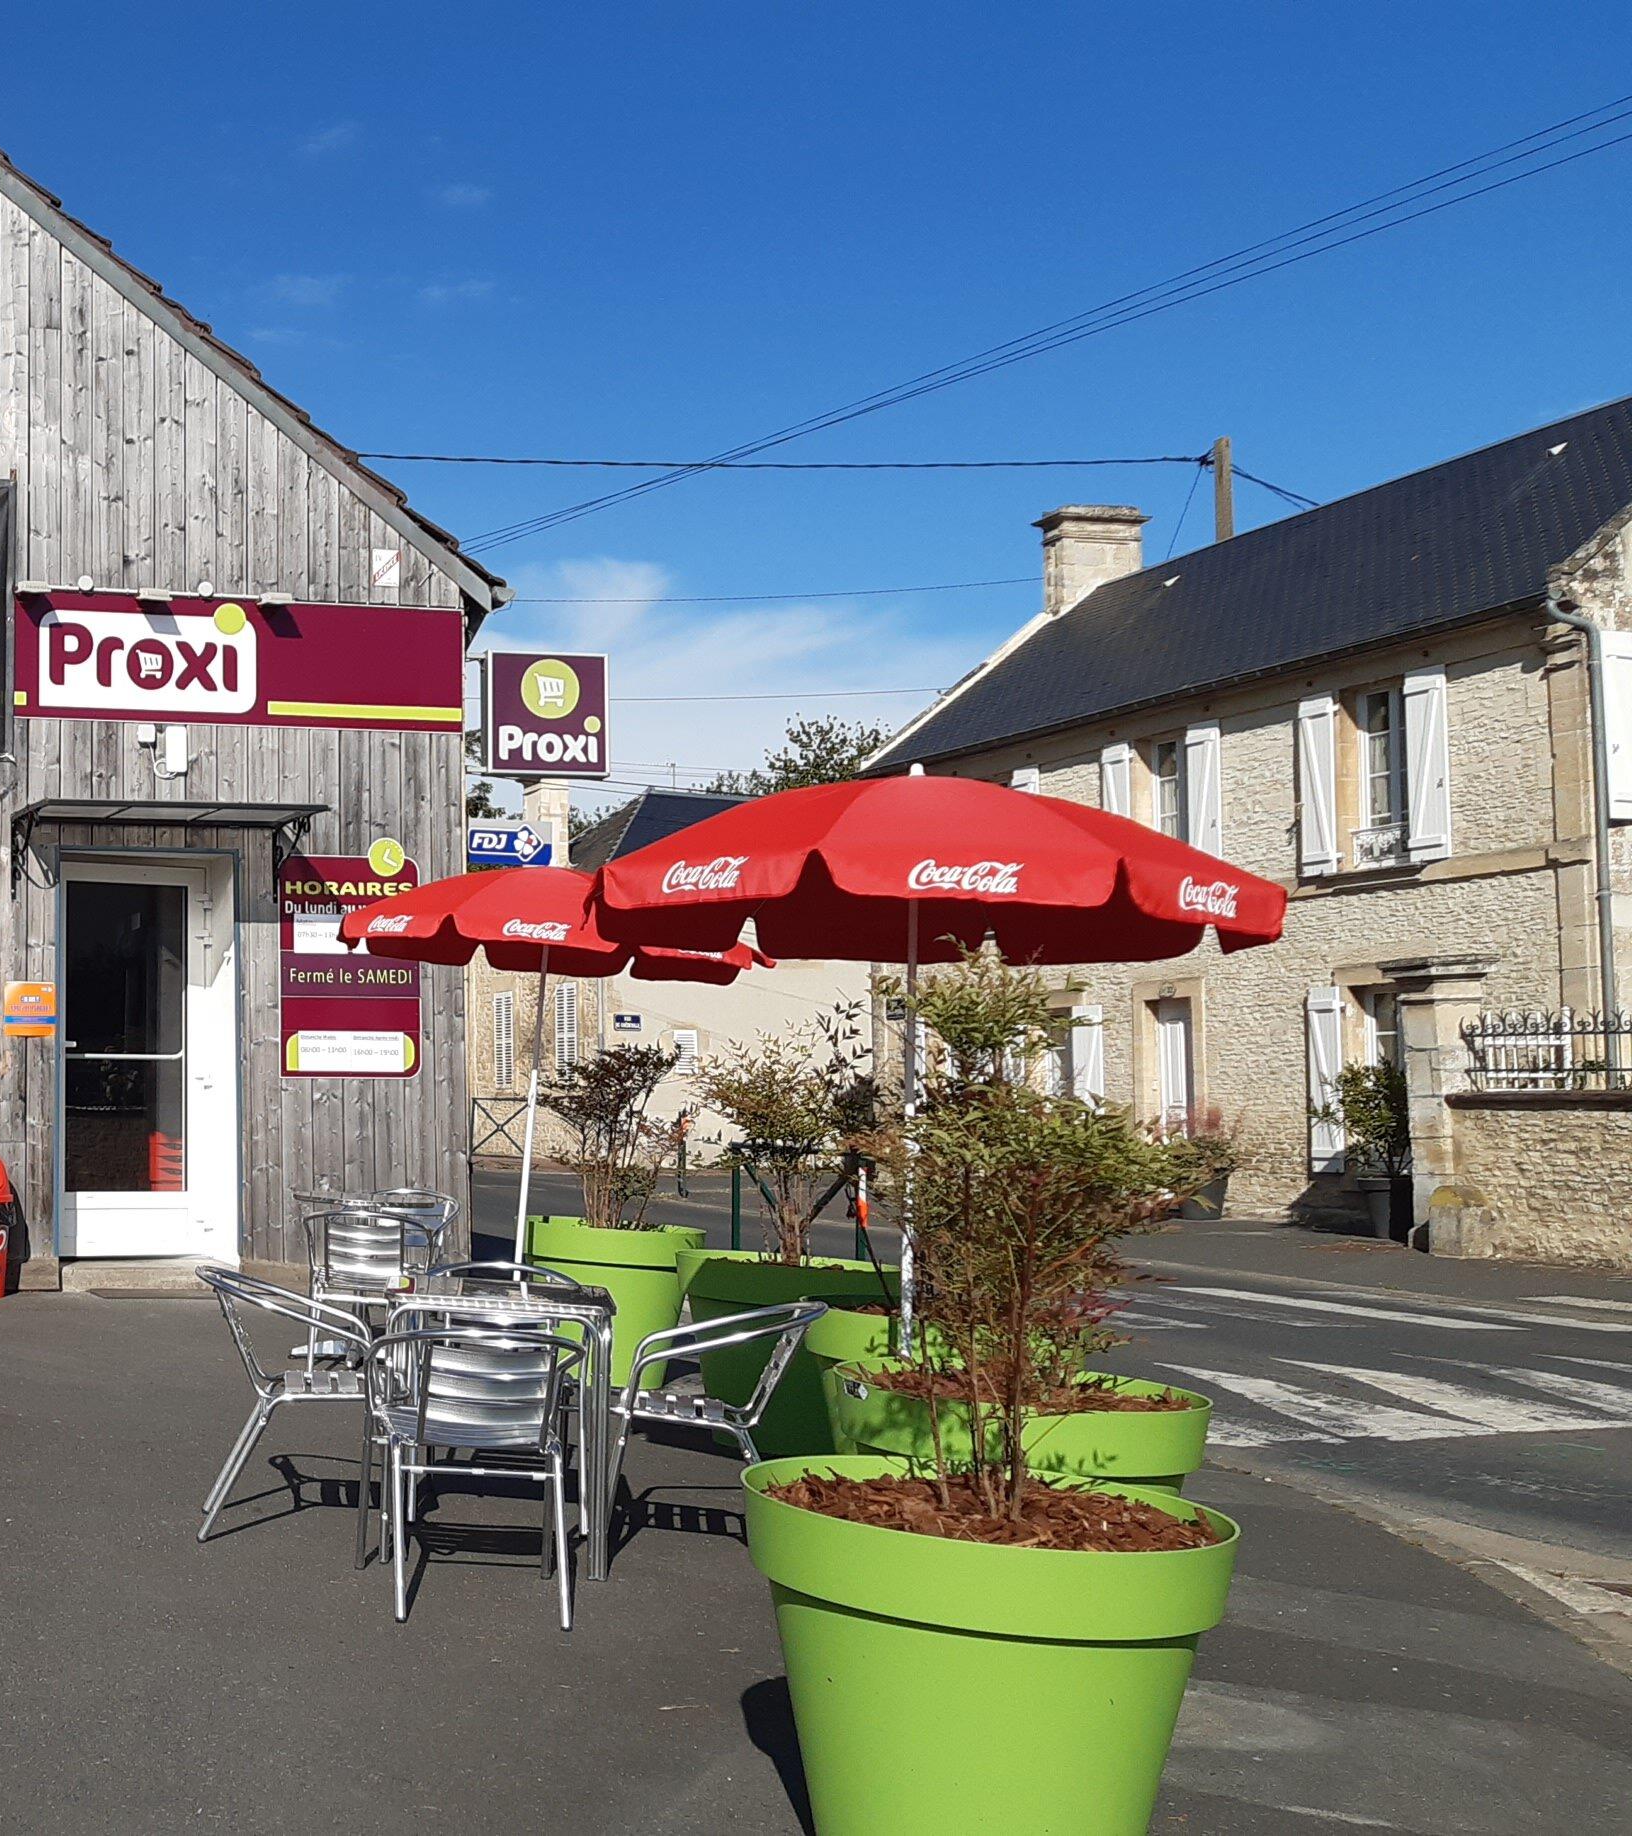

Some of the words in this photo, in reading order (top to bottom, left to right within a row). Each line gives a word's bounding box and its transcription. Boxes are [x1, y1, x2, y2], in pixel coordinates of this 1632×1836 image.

[49, 603, 246, 692] Proxi
[498, 716, 601, 764] Proxi
[471, 832, 508, 850] FDJ
[285, 880, 413, 897] HORAIRES
[662, 855, 750, 894] Coca-Cola
[908, 858, 1025, 894] Coca-Cola
[284, 900, 302, 914] Du
[305, 901, 337, 914] lundi
[1178, 876, 1240, 918] Coca-Cola
[502, 918, 572, 941] Coca-Cola
[289, 968, 334, 983] Fermé
[339, 968, 353, 984] le
[357, 969, 413, 984] SAMEDI
